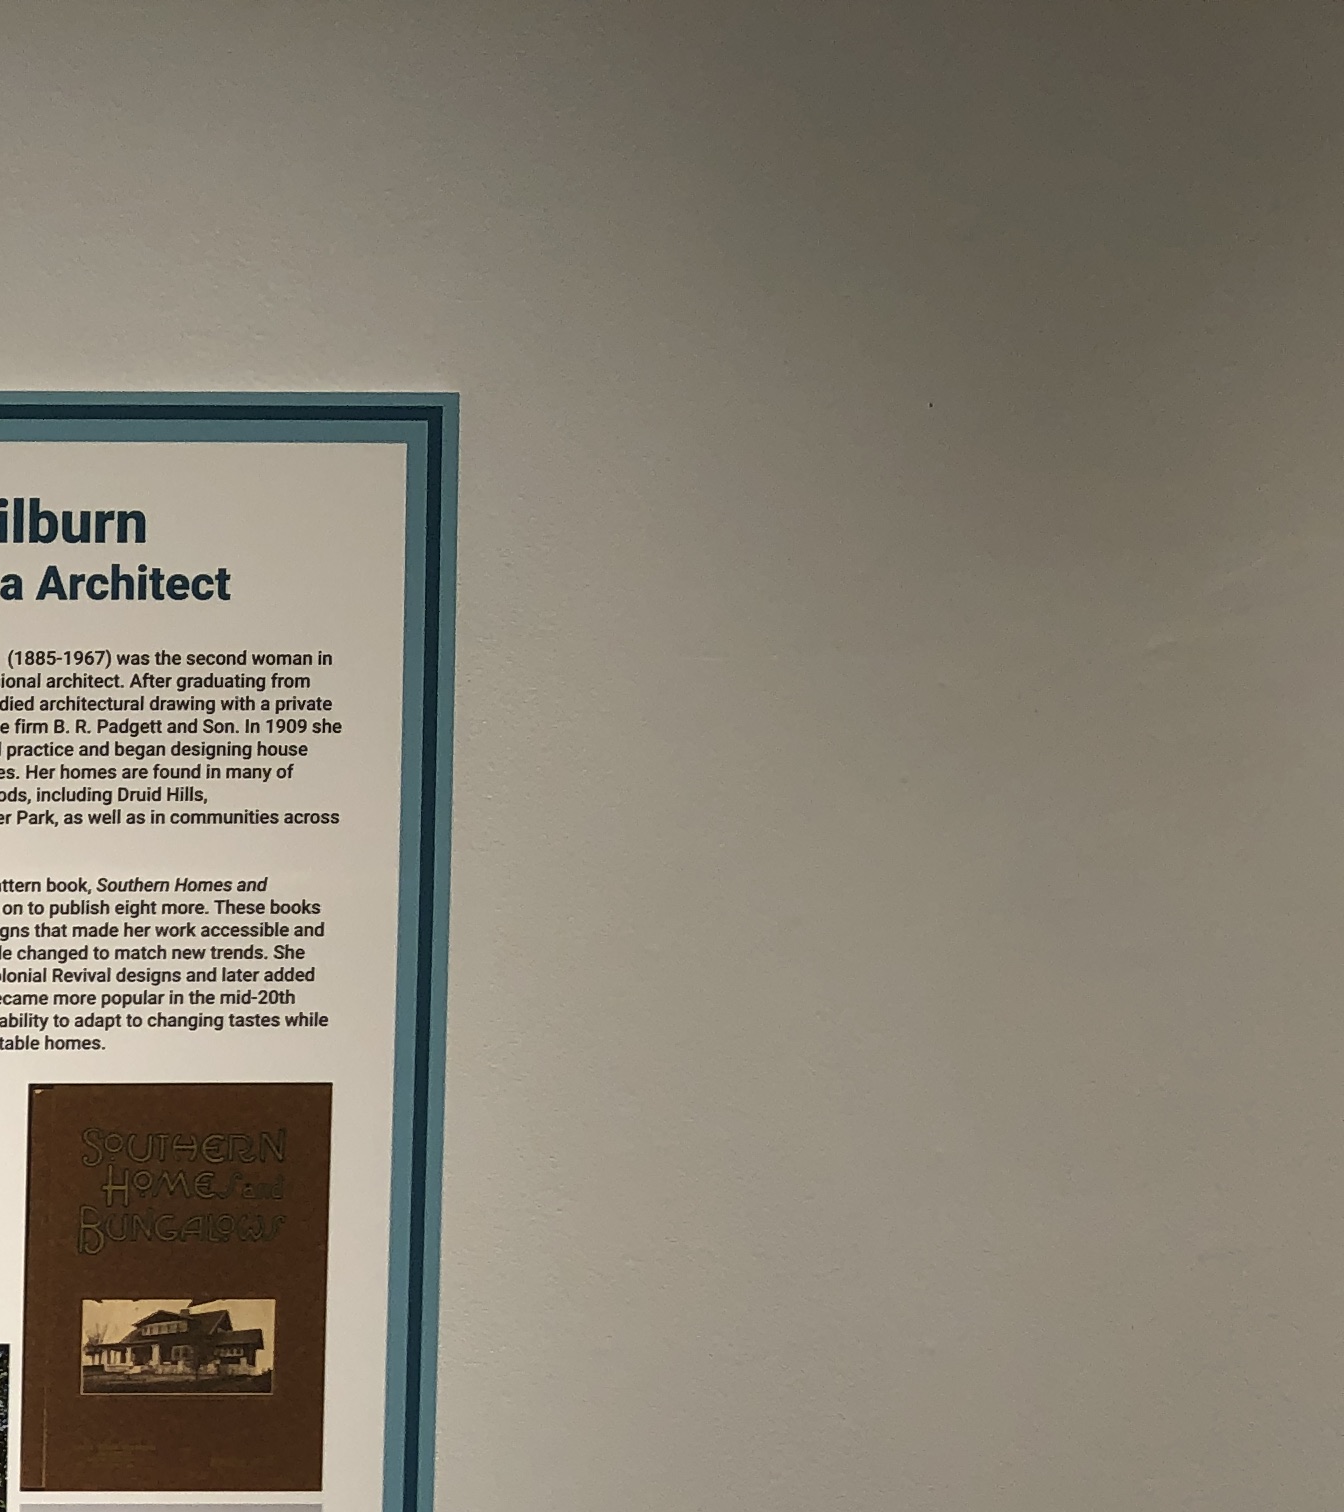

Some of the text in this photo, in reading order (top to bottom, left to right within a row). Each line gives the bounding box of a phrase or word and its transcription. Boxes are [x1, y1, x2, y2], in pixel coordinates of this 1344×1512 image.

[35, 563, 231, 601] Architect
[8, 649, 111, 669] (1885-1967)
[116, 654, 150, 665] was
[154, 650, 181, 665] the
[186, 650, 247, 665] second
[252, 654, 313, 665] woman
[318, 650, 332, 665] in
[45, 1035, 106, 1050] homes.
[81, 1128, 288, 1167] SOUTHERN
[76, 1205, 287, 1254] BUNGALOWS
